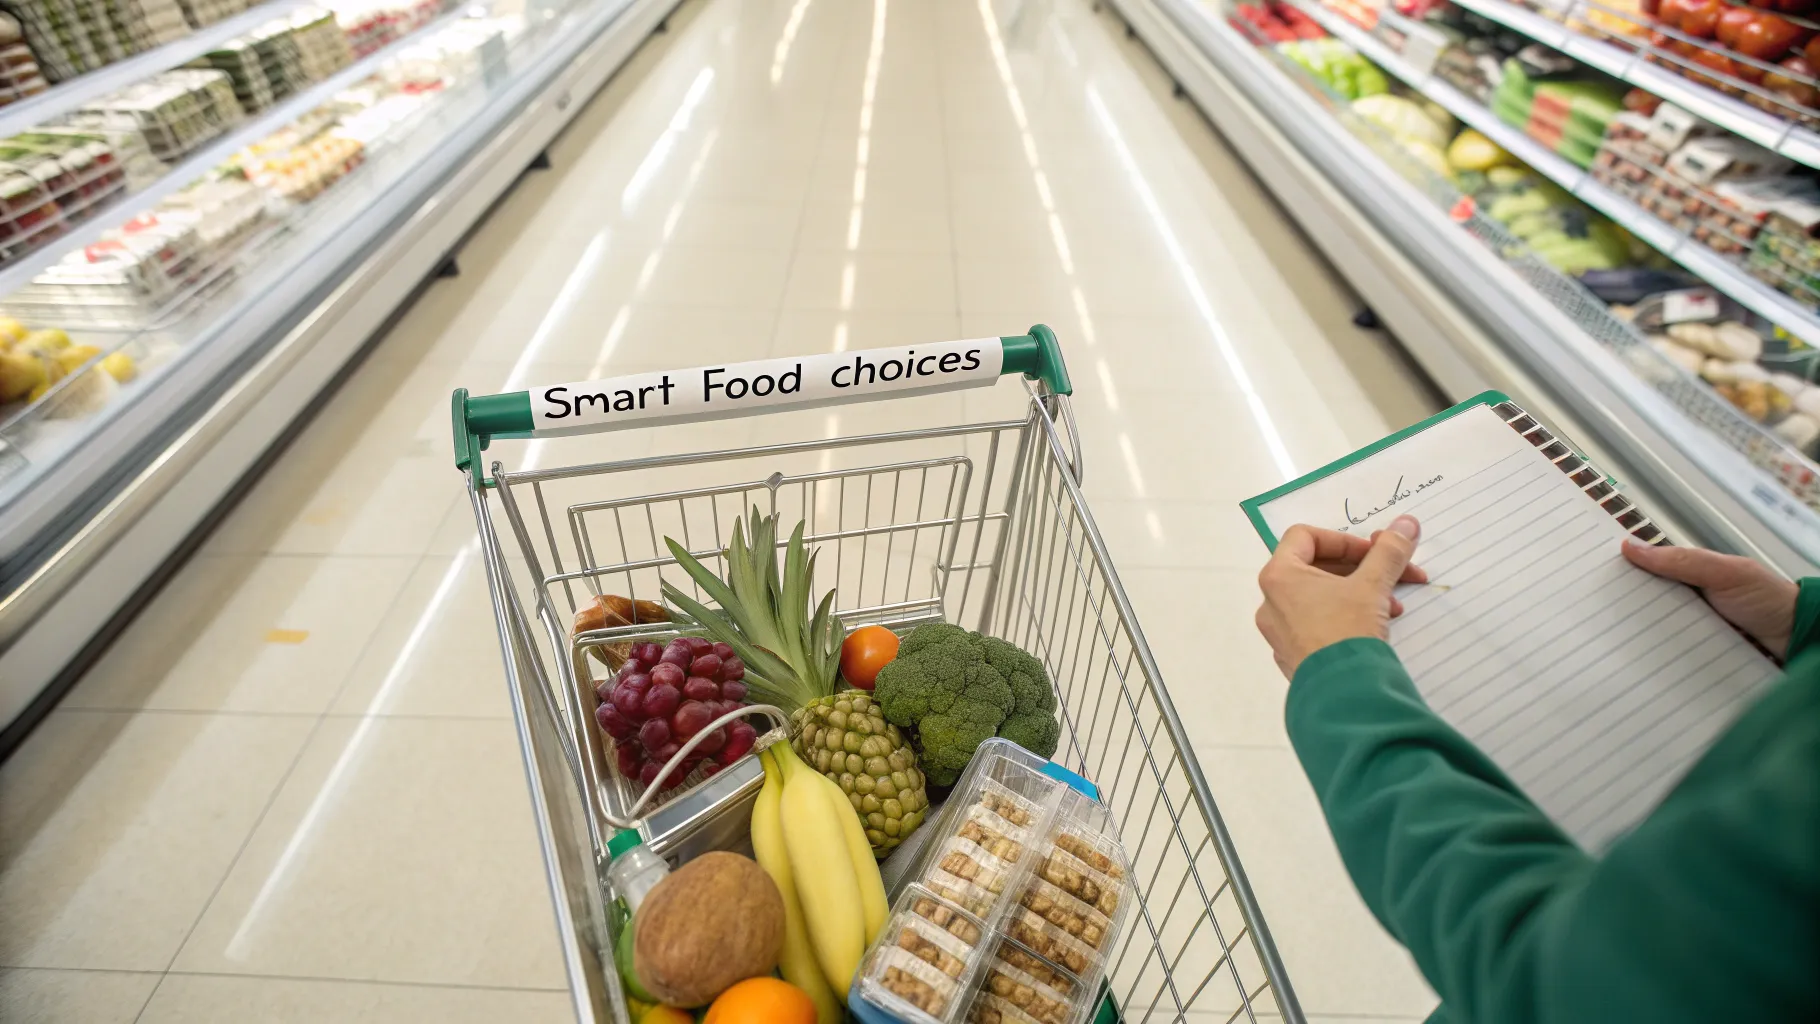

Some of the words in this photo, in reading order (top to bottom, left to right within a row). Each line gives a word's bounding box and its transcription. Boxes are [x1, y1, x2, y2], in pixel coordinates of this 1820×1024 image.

[544, 375, 675, 419] Smart
[703, 363, 802, 403] Food
[831, 348, 981, 388] choices
